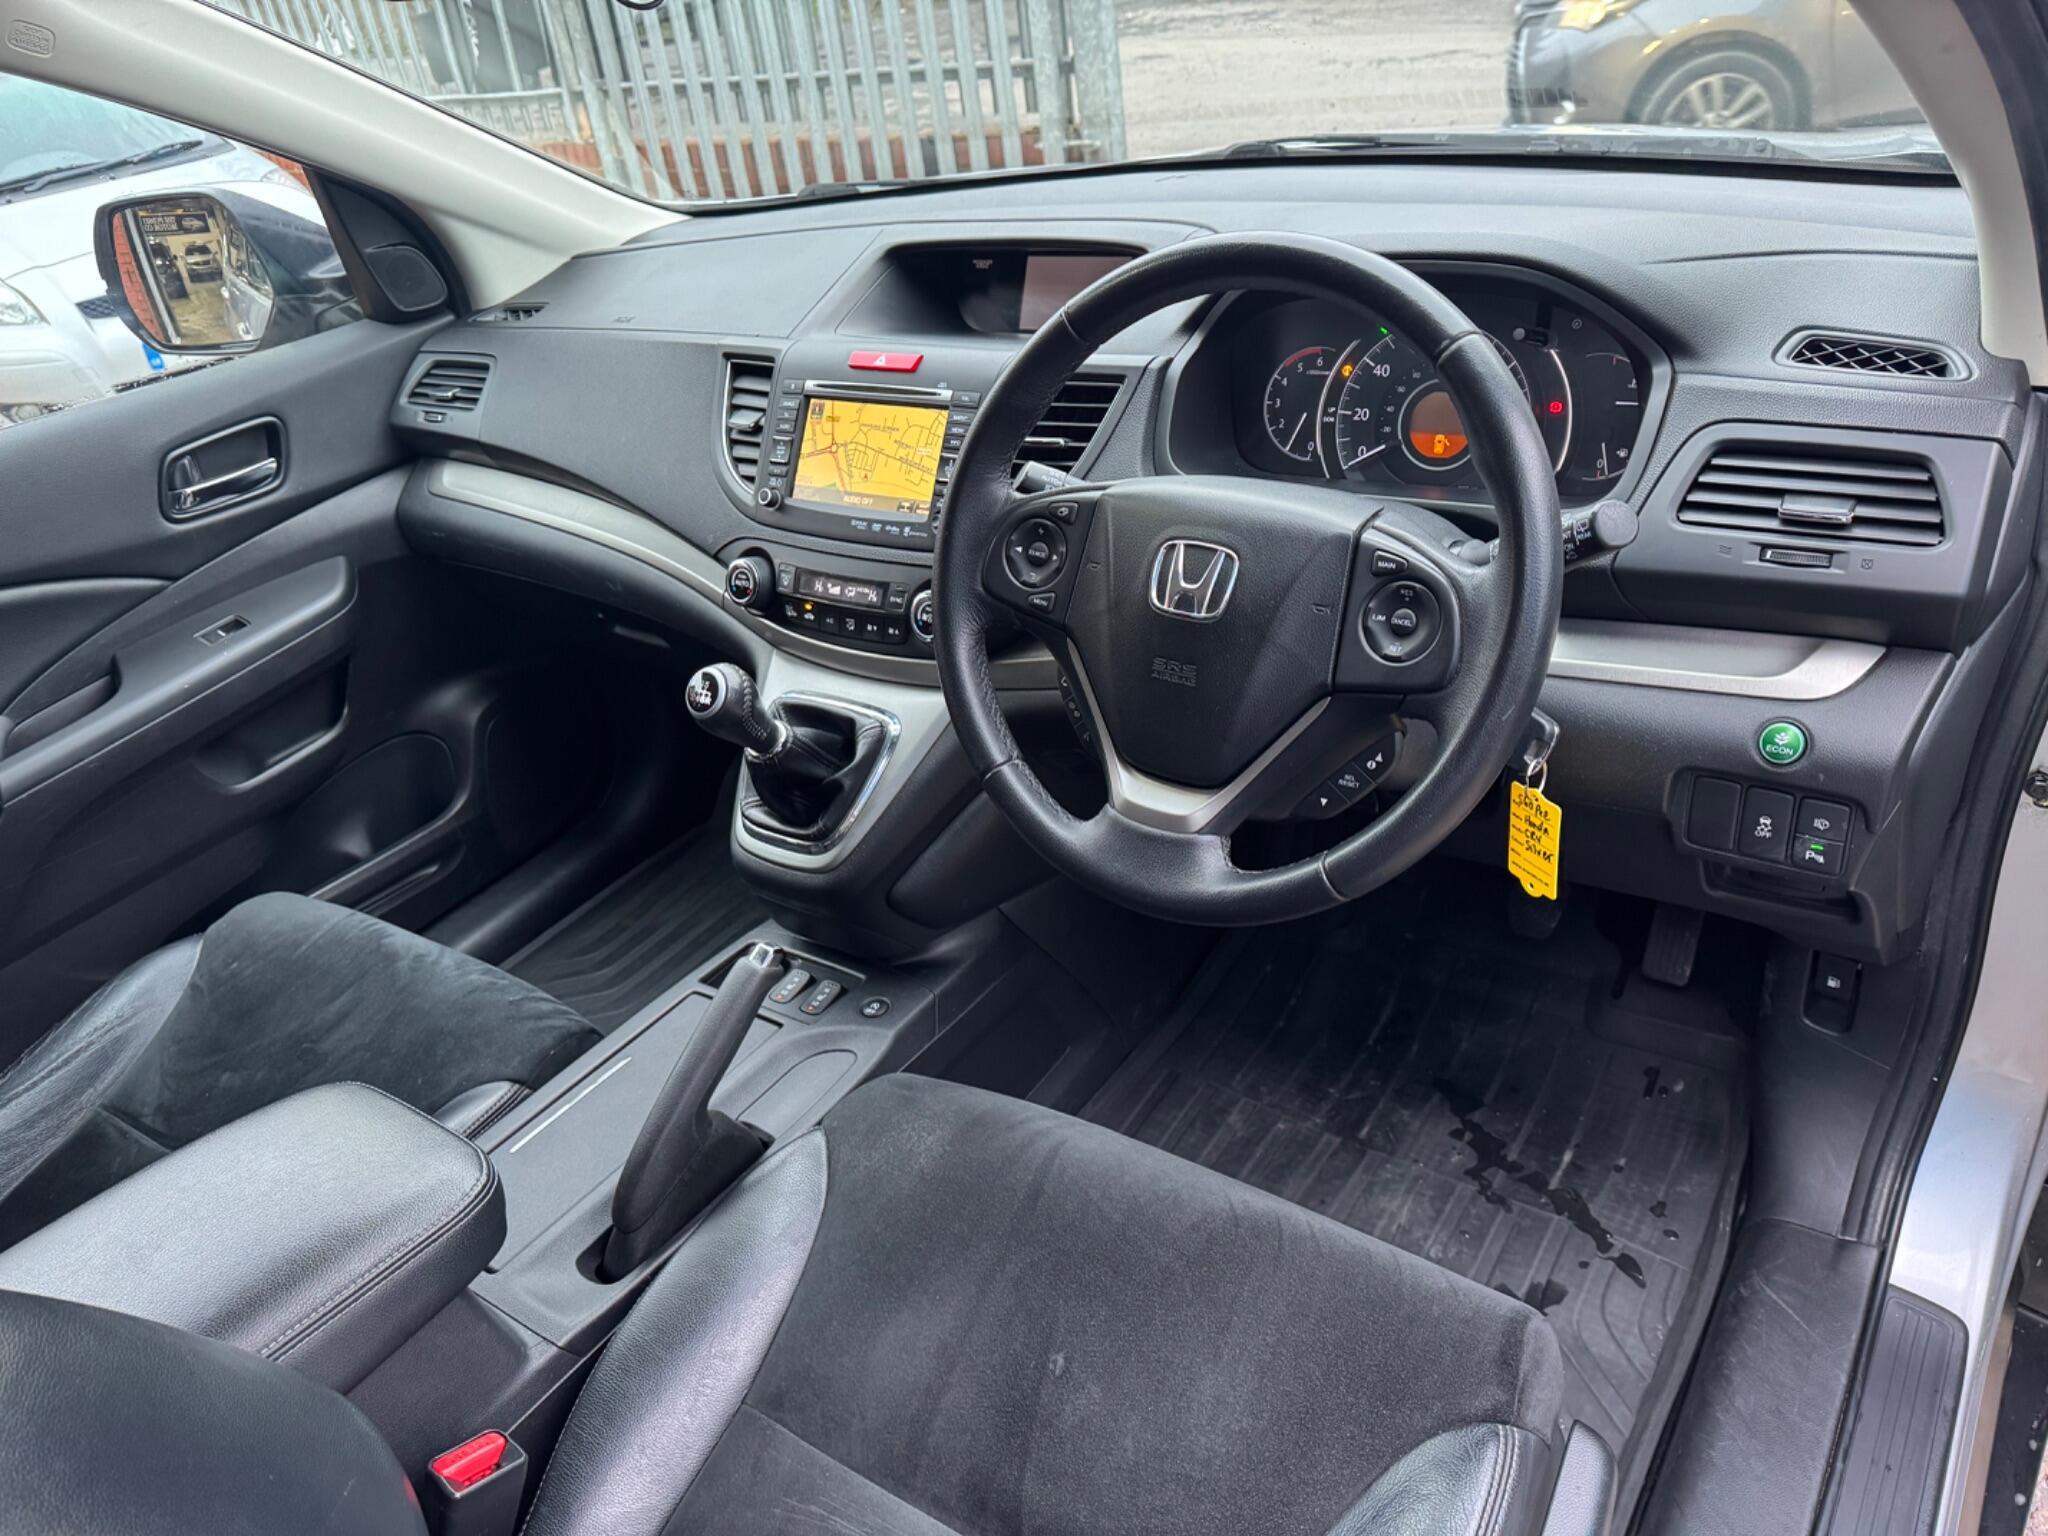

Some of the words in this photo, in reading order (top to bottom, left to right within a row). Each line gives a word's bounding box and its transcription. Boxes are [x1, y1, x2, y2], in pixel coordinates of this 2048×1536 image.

[1373, 364, 1390, 377] 40
[1353, 408, 1369, 421] 20
[1378, 561, 1396, 569] MAIN
[1371, 613, 1386, 621] LIM
[1390, 617, 1412, 627] CANCEL
[1152, 657, 1198, 677] SRS
[1766, 744, 1794, 756] ECON
[1755, 829, 1772, 839] OFF
